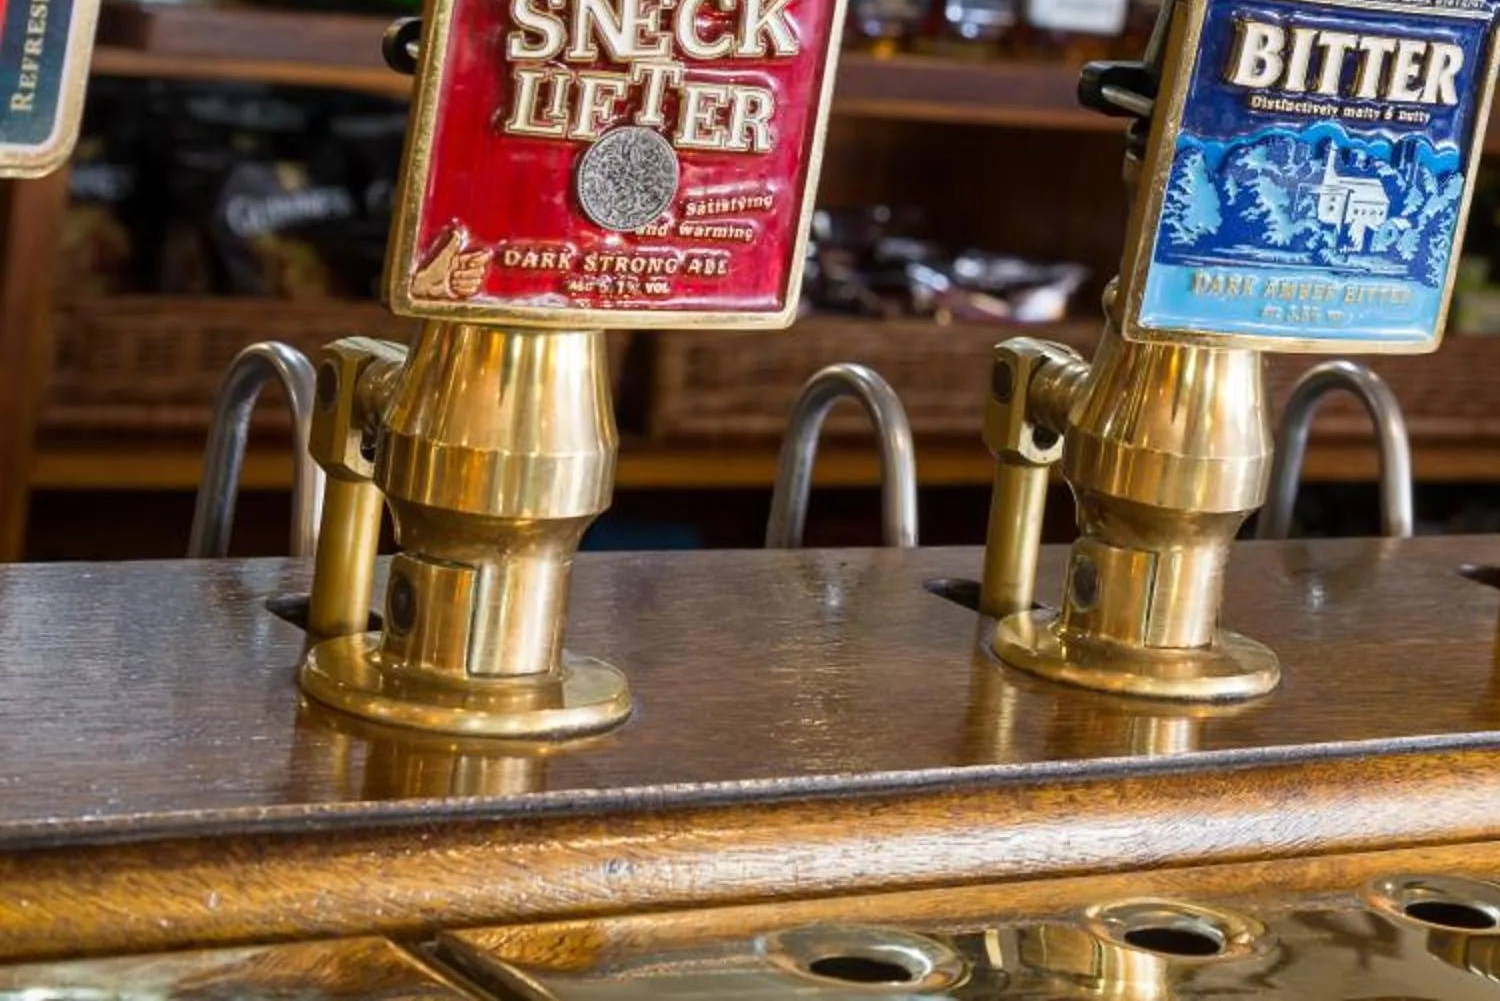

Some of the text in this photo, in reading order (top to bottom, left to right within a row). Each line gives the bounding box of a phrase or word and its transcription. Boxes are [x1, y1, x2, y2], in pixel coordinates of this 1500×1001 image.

[1232, 20, 1466, 106] BITTER
[505, 59, 777, 153] LIFTER
[1250, 94, 1339, 116] Distinctively
[685, 194, 774, 217] Satisfying
[635, 224, 754, 242] and warming
[503, 248, 729, 276] DARK STRONG ALE
[645, 281, 671, 295] VOL
[1191, 270, 1256, 297] DARK
[1263, 277, 1338, 302] AMBER
